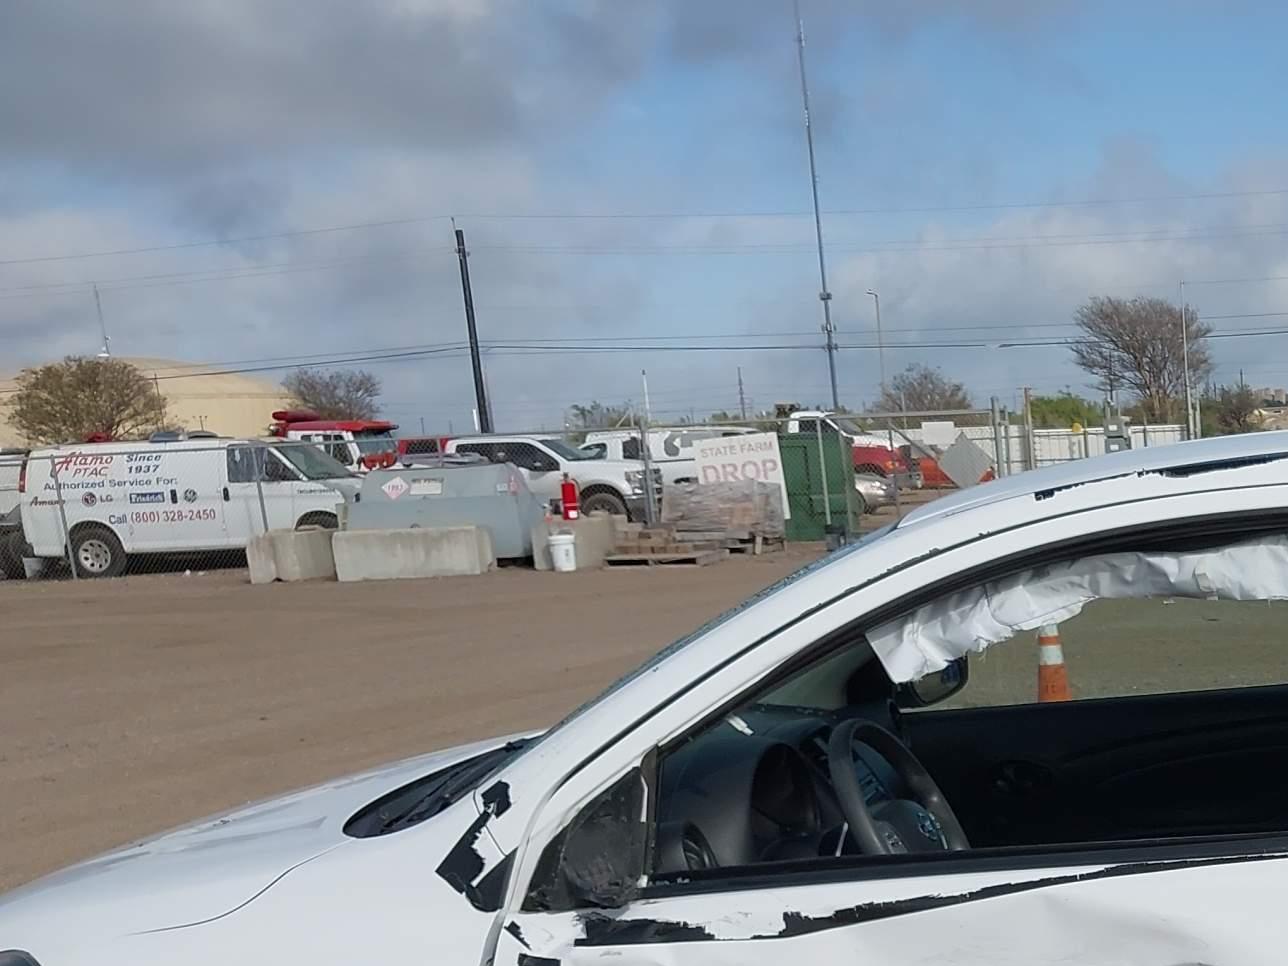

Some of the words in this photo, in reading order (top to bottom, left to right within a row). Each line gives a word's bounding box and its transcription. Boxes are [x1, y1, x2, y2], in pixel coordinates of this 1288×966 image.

[700, 445, 737, 458] STATE
[740, 441, 773, 454] FARM
[54, 451, 113, 476] Alamo
[126, 453, 162, 463] Since
[72, 467, 109, 478] PTAC
[127, 464, 160, 474] 1937
[702, 459, 778, 482] DROP
[44, 480, 105, 490] Authorized
[109, 479, 152, 488] Service
[156, 477, 178, 486] For:
[100, 494, 114, 503] LG
[108, 513, 128, 525] Call
[130, 511, 160, 524] (800)
[163, 508, 216, 522] 328-2450
